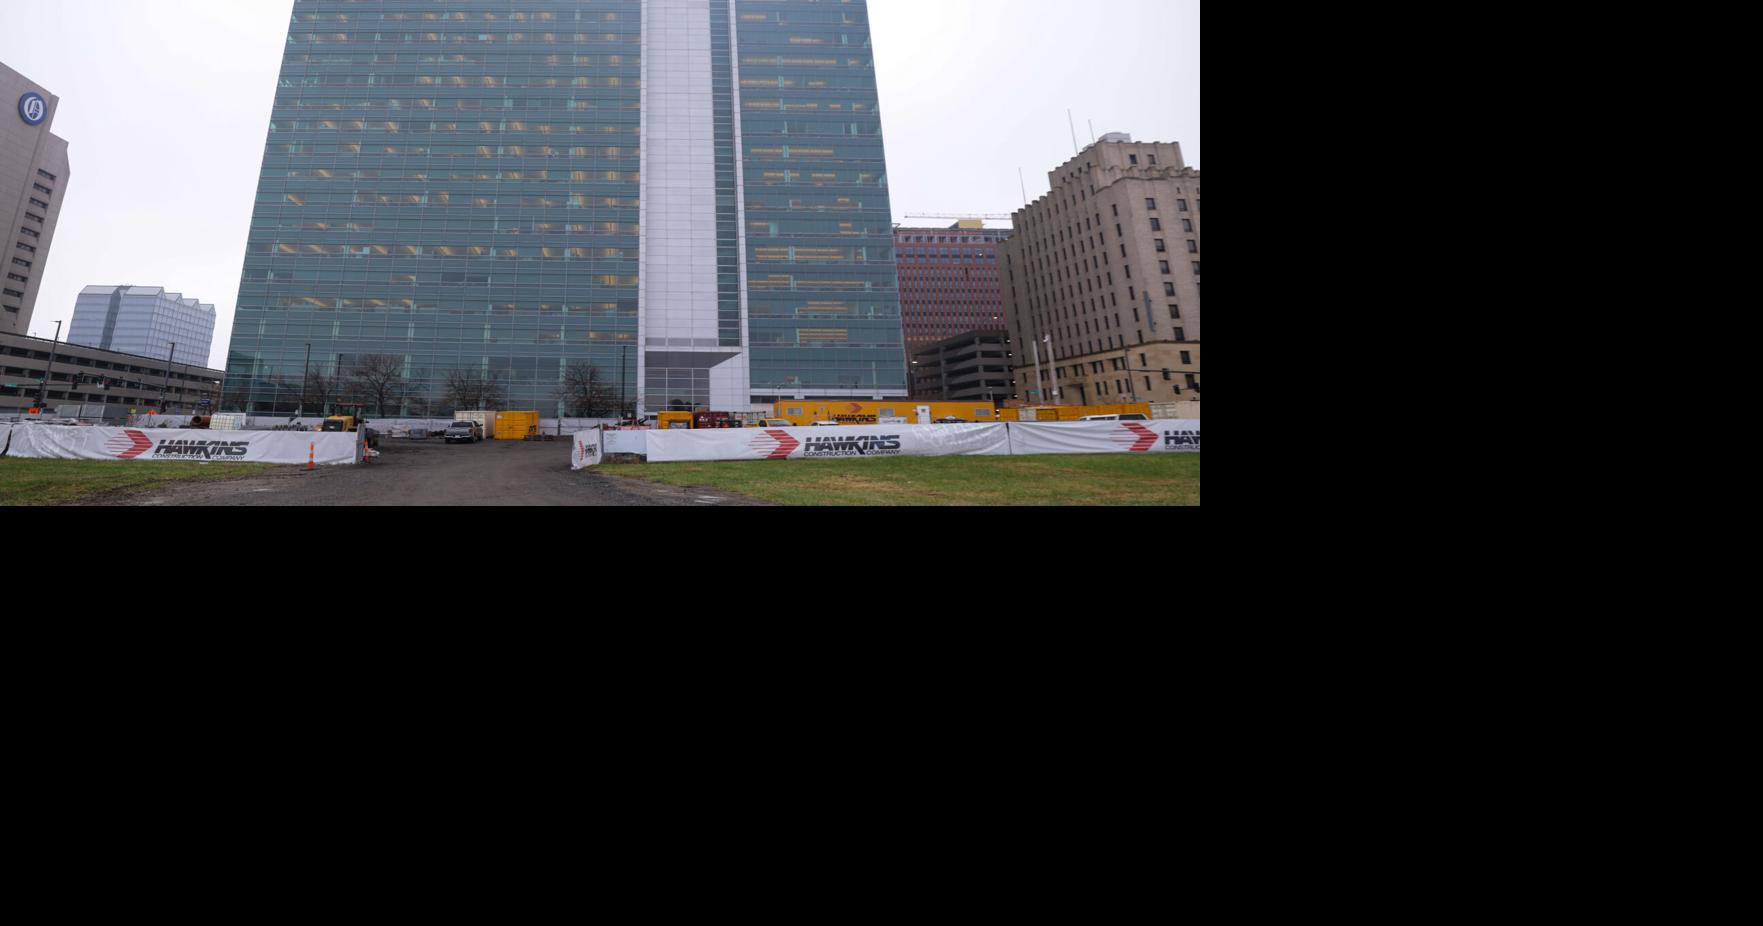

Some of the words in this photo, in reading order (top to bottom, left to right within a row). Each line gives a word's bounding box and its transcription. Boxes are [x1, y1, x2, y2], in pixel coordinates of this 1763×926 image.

[154, 439, 250, 459] HAWKINS
[804, 434, 901, 455] HAWKINS
[866, 448, 901, 456] COMPANY
